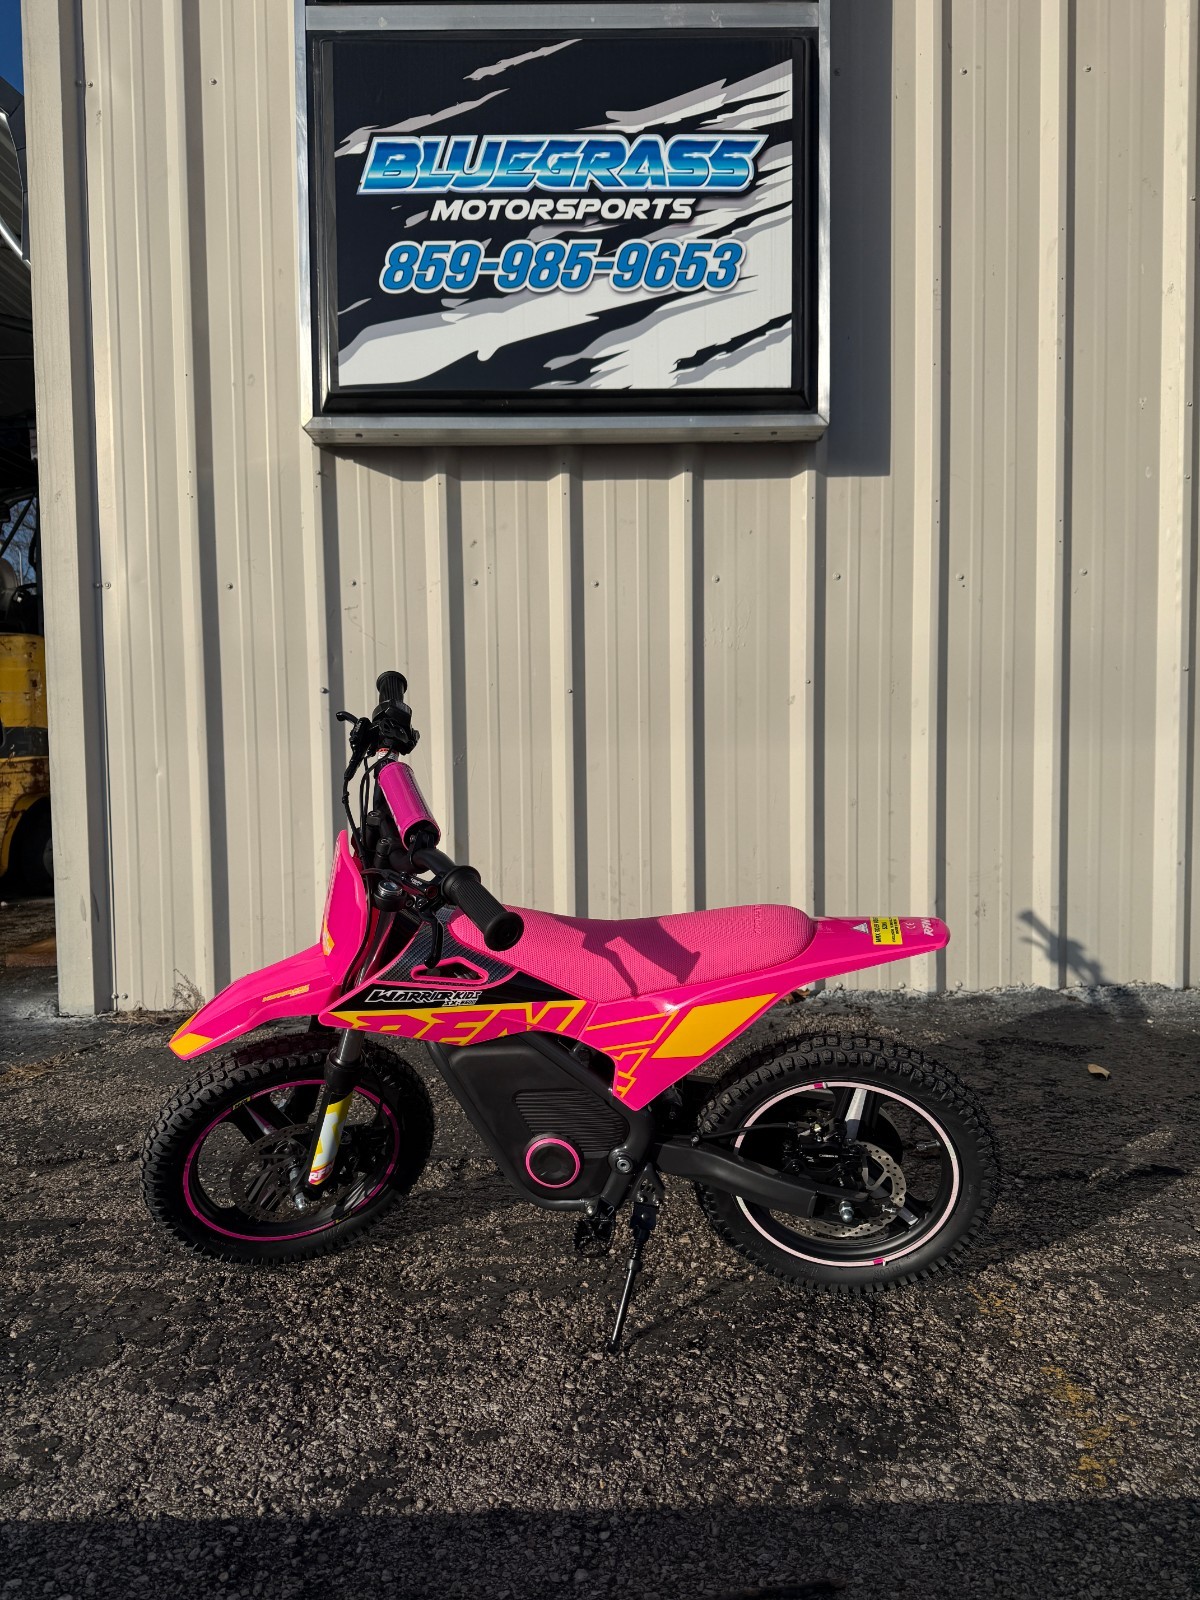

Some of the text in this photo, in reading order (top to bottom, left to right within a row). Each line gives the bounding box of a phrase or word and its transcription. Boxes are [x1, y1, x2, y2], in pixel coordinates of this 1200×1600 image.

[359, 134, 768, 193] BLUEGRASS
[431, 198, 695, 221] MOTORSPORTS
[380, 240, 746, 292] 859-985-9653
[365, 989, 453, 1002] WARRIOR
